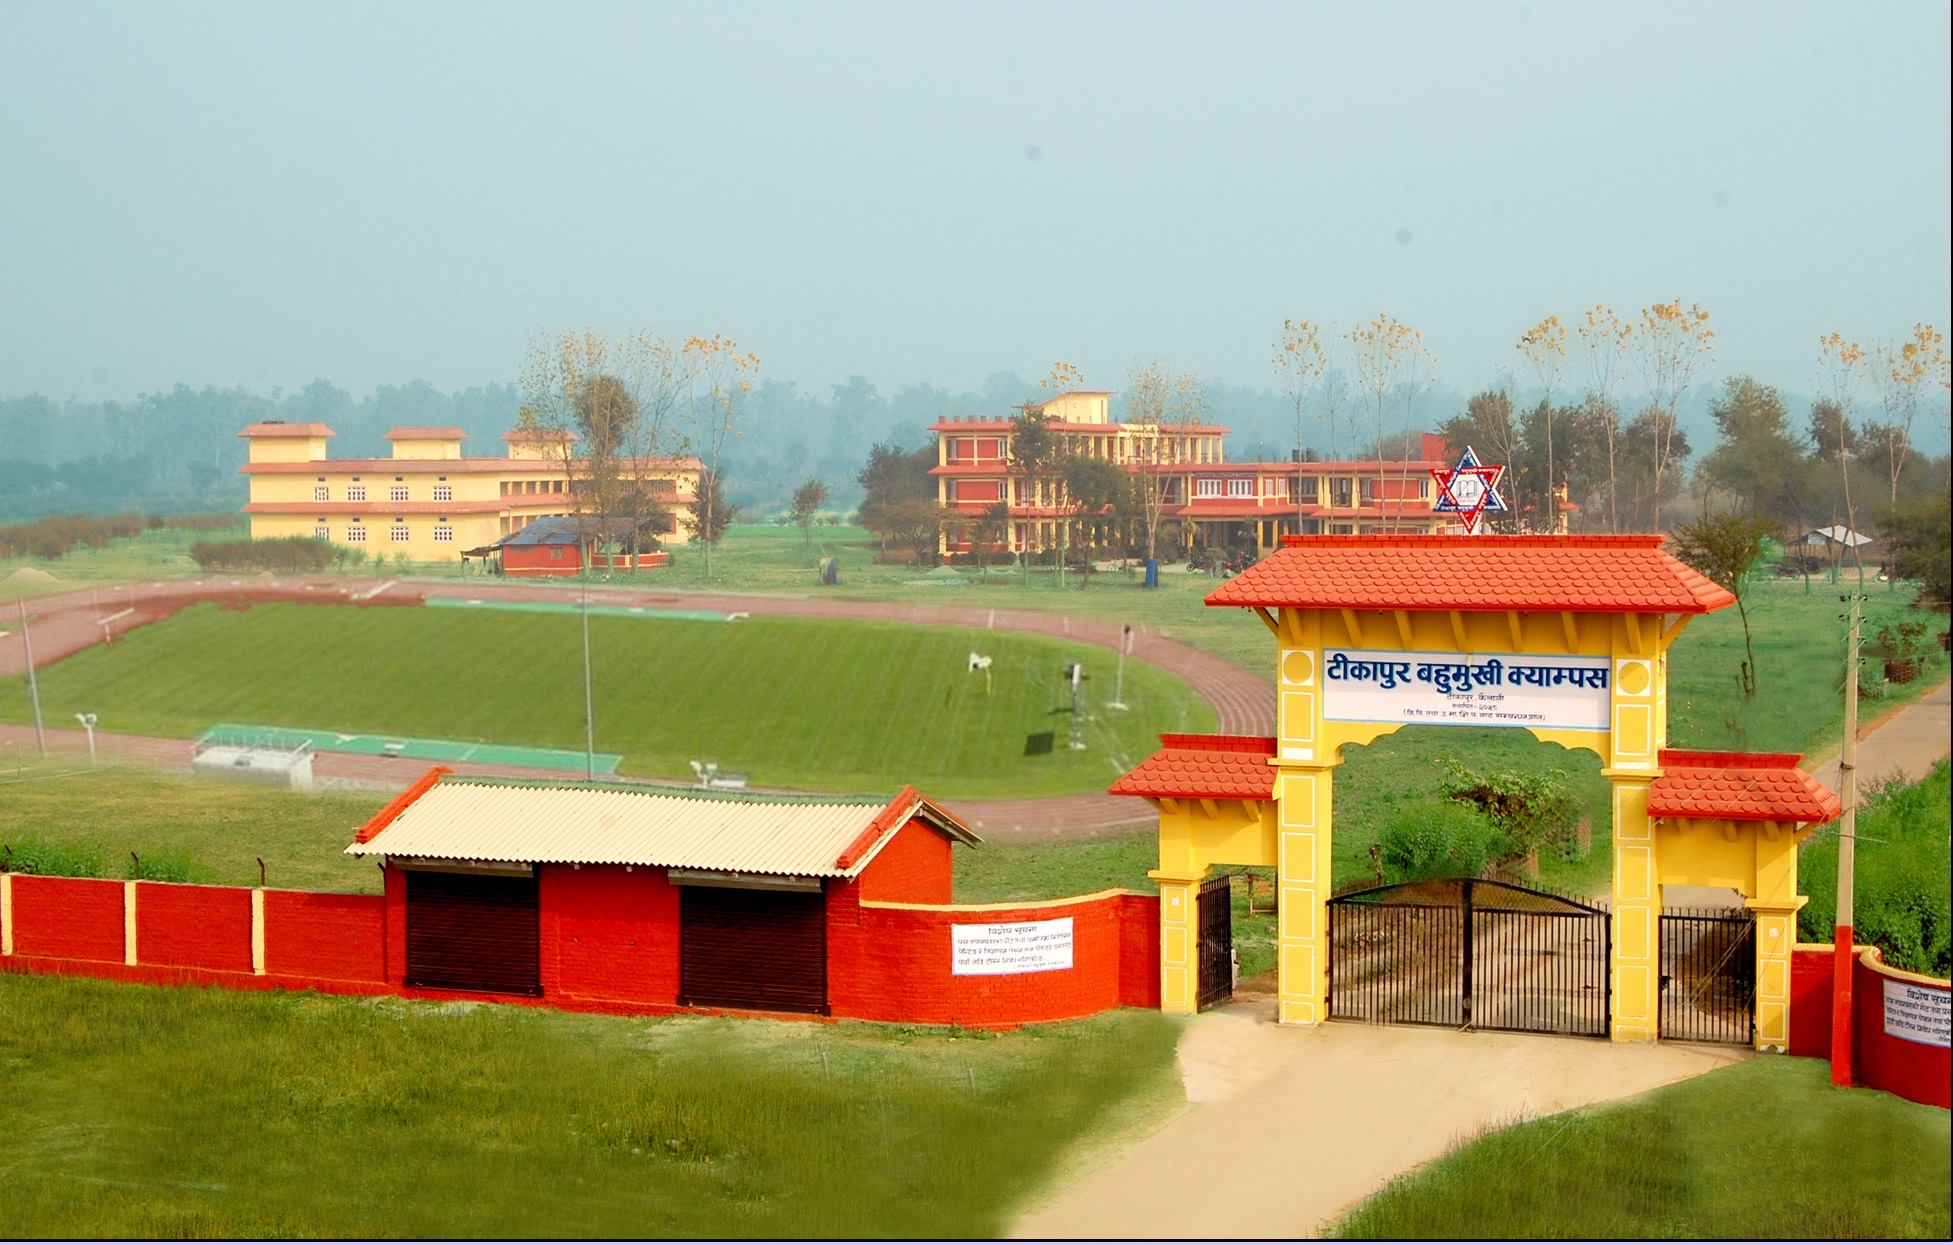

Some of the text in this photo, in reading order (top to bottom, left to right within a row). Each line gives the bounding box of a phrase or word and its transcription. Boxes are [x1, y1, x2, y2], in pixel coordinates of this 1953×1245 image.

[1327, 653, 1608, 693] टीकापुर बहुमुखी क्याम्पस
